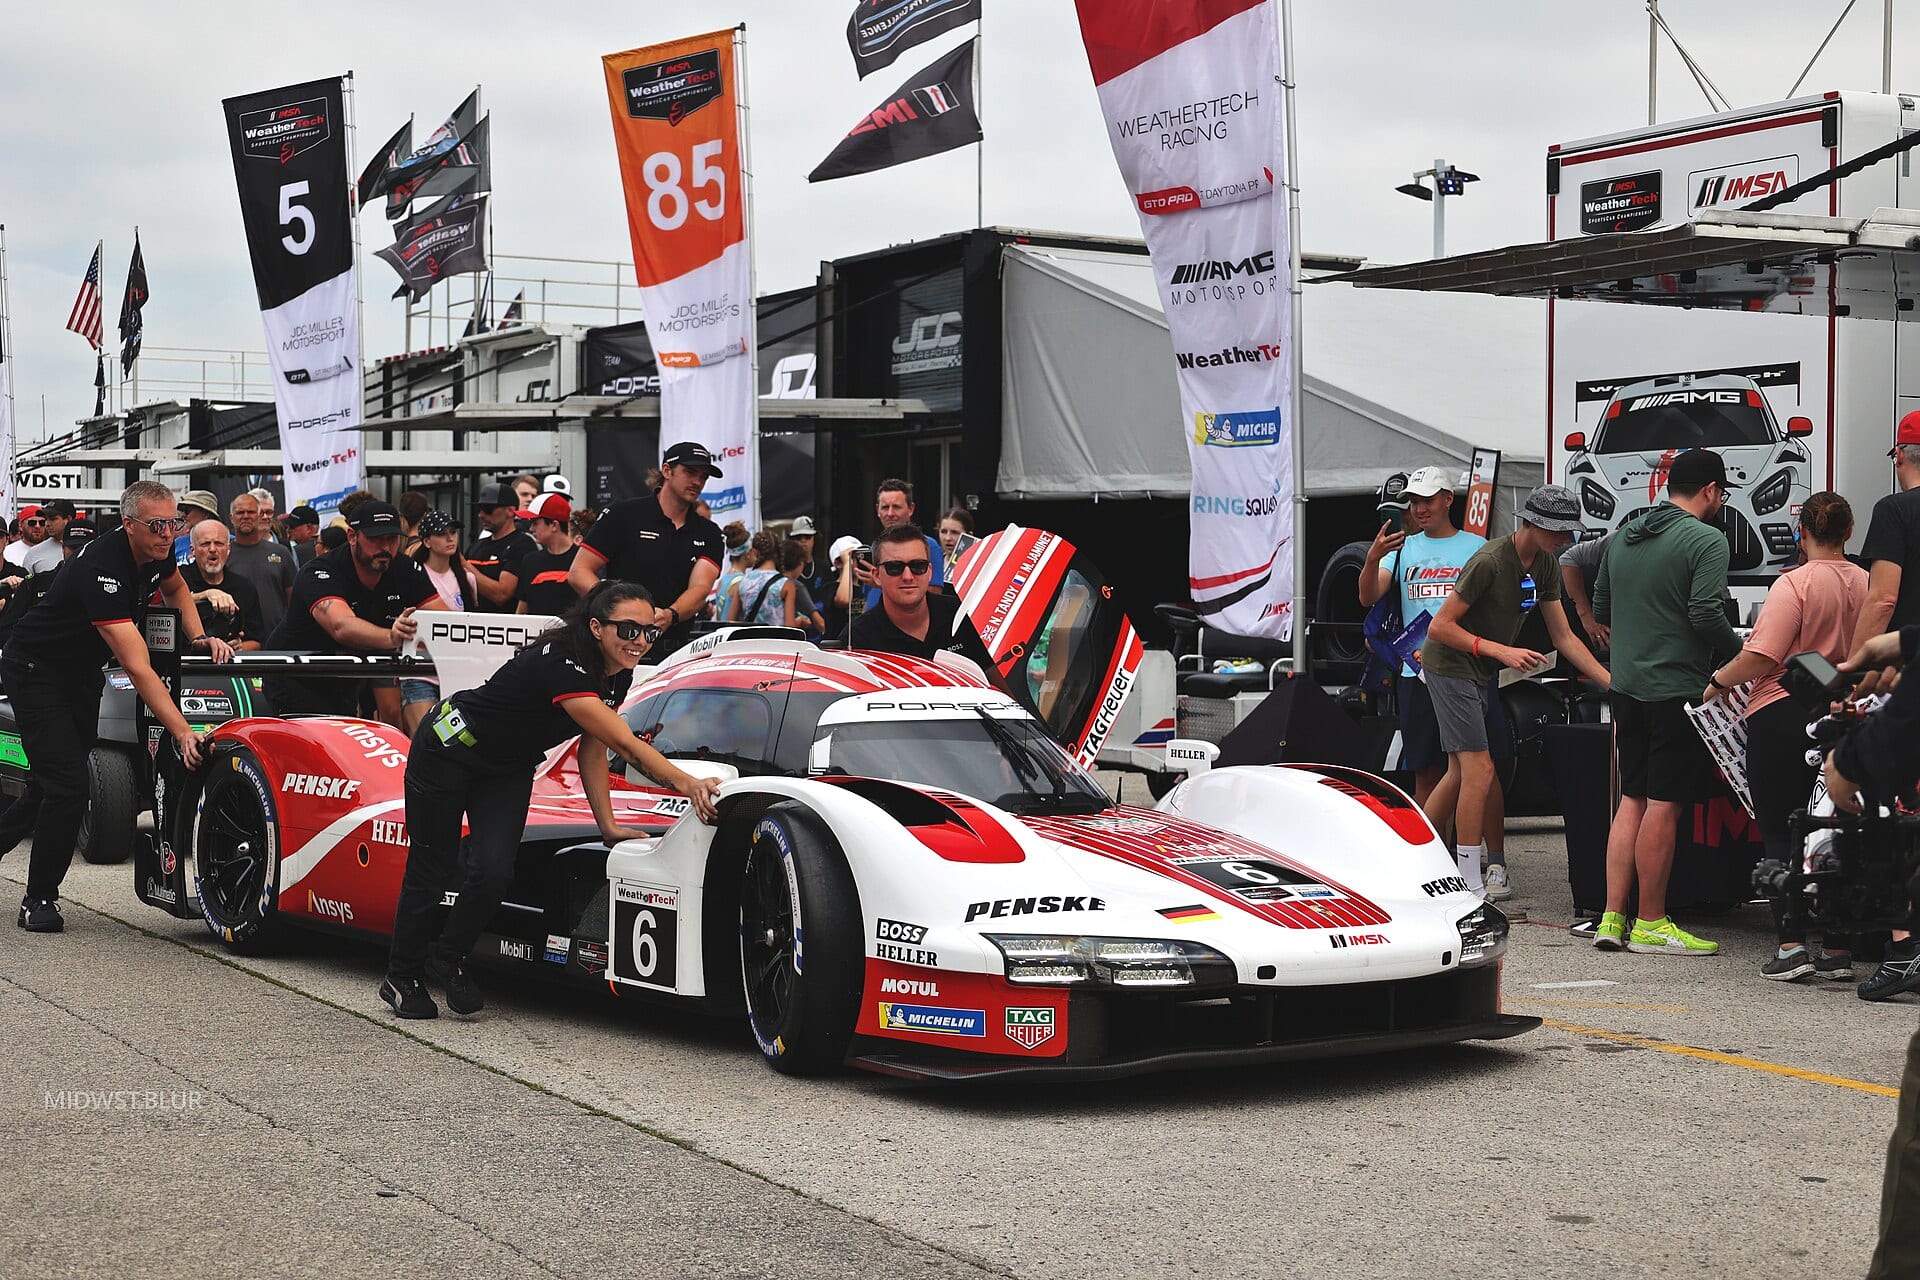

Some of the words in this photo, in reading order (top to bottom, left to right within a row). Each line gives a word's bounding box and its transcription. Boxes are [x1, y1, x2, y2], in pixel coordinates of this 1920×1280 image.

[630, 69, 717, 98] WeatherTech
[278, 107, 302, 119] IMSA
[1117, 89, 1260, 138] WEATHERTECH
[245, 114, 325, 139] WeatherTech
[1161, 121, 1228, 151] RACING
[642, 138, 726, 231] 85
[1614, 181, 1637, 192] IMSA
[1723, 171, 1789, 201] IMSA
[1584, 192, 1658, 213] WeatherTech
[279, 180, 316, 255] 5
[671, 304, 699, 319] JDC
[291, 325, 308, 338] JDC
[309, 316, 343, 333] MILLER
[288, 408, 351, 430] PORSCHE
[1469, 490, 1489, 527] 85
[996, 583, 1018, 617] TANDY
[1025, 530, 1054, 569] JAMINET
[149, 619, 171, 628] HYBRID
[156, 636, 171, 645] BOSCH
[690, 637, 714, 655] Mobil
[1170, 749, 1206, 761] HELLER
[244, 766, 271, 818] MICHELIN
[282, 772, 362, 800] PENSKE
[371, 819, 411, 847] HEL
[761, 820, 787, 853] MICHELIN
[1220, 862, 1280, 884] 6
[964, 896, 1106, 923] PENSKE
[879, 920, 924, 943] BOSS
[1349, 934, 1391, 946] IMSA
[500, 939, 524, 960] Mobil
[632, 909, 658, 977] 6
[876, 943, 938, 967] HELLER
[880, 978, 940, 997] MOTUL
[908, 1013, 976, 1030] MICHELIN
[1009, 1009, 1049, 1023] TAG
[1007, 1025, 1052, 1047] HEUER
